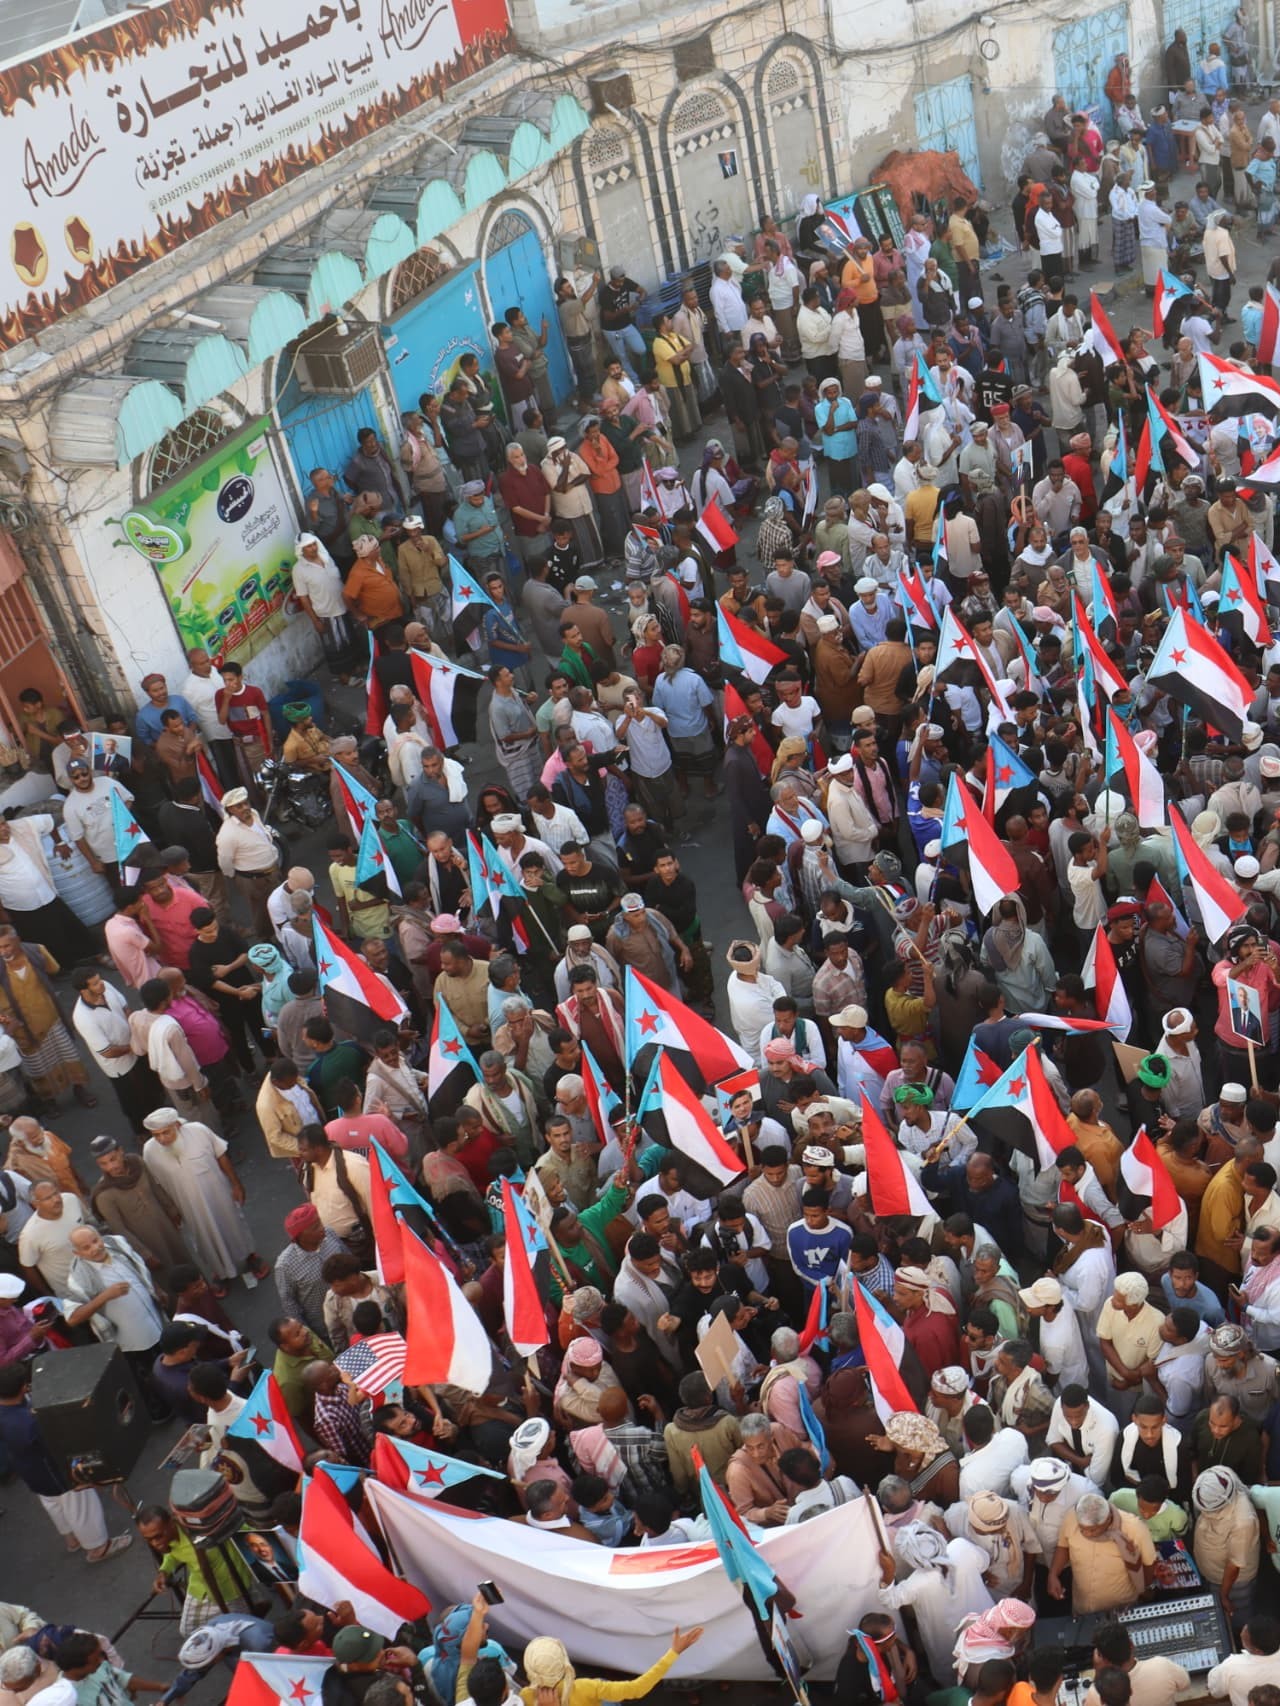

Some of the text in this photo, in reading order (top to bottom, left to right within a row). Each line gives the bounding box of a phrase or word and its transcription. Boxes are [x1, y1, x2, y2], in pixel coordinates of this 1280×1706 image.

[106, 34, 247, 138] للتجارة
[240, 77, 303, 131] الغذائية
[306, 58, 340, 97] المواد
[22, 104, 105, 207] Amada
